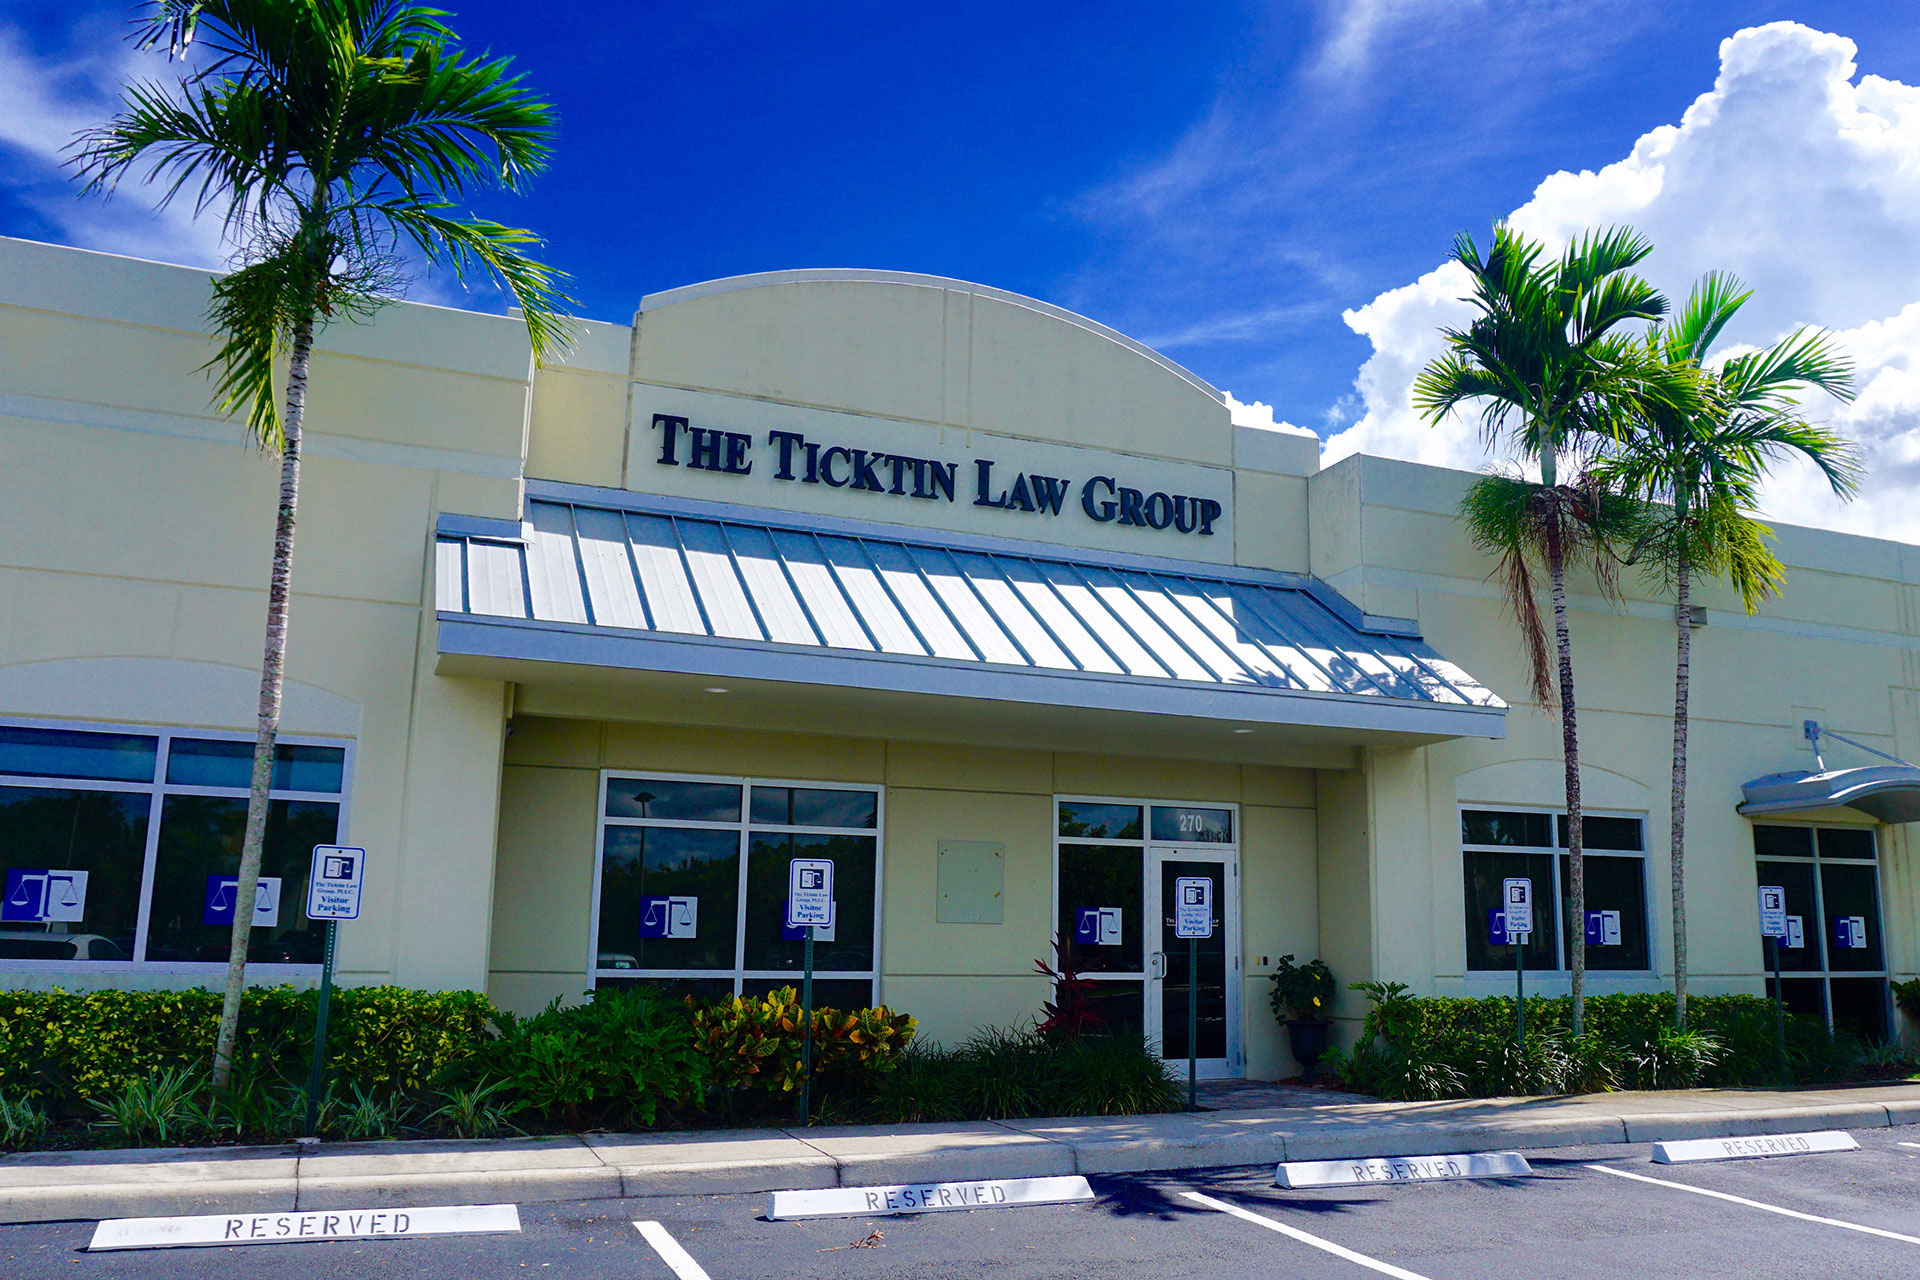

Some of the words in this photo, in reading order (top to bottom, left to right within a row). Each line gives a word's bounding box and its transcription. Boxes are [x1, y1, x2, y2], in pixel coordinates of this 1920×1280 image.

[652, 413, 753, 475] THE
[768, 430, 959, 503] TICKTIN
[973, 459, 1071, 517] LAW
[1081, 475, 1222, 536] GROUP
[1179, 814, 1203, 832] 270
[317, 903, 351, 914] Parking
[321, 895, 349, 904] Visitor
[797, 911, 824, 920] Parking
[1721, 1136, 1810, 1156] RESERVED
[1351, 1161, 1461, 1181] RESERVED
[865, 1185, 1006, 1210] RESERVED
[225, 1213, 411, 1239] RESERVED
